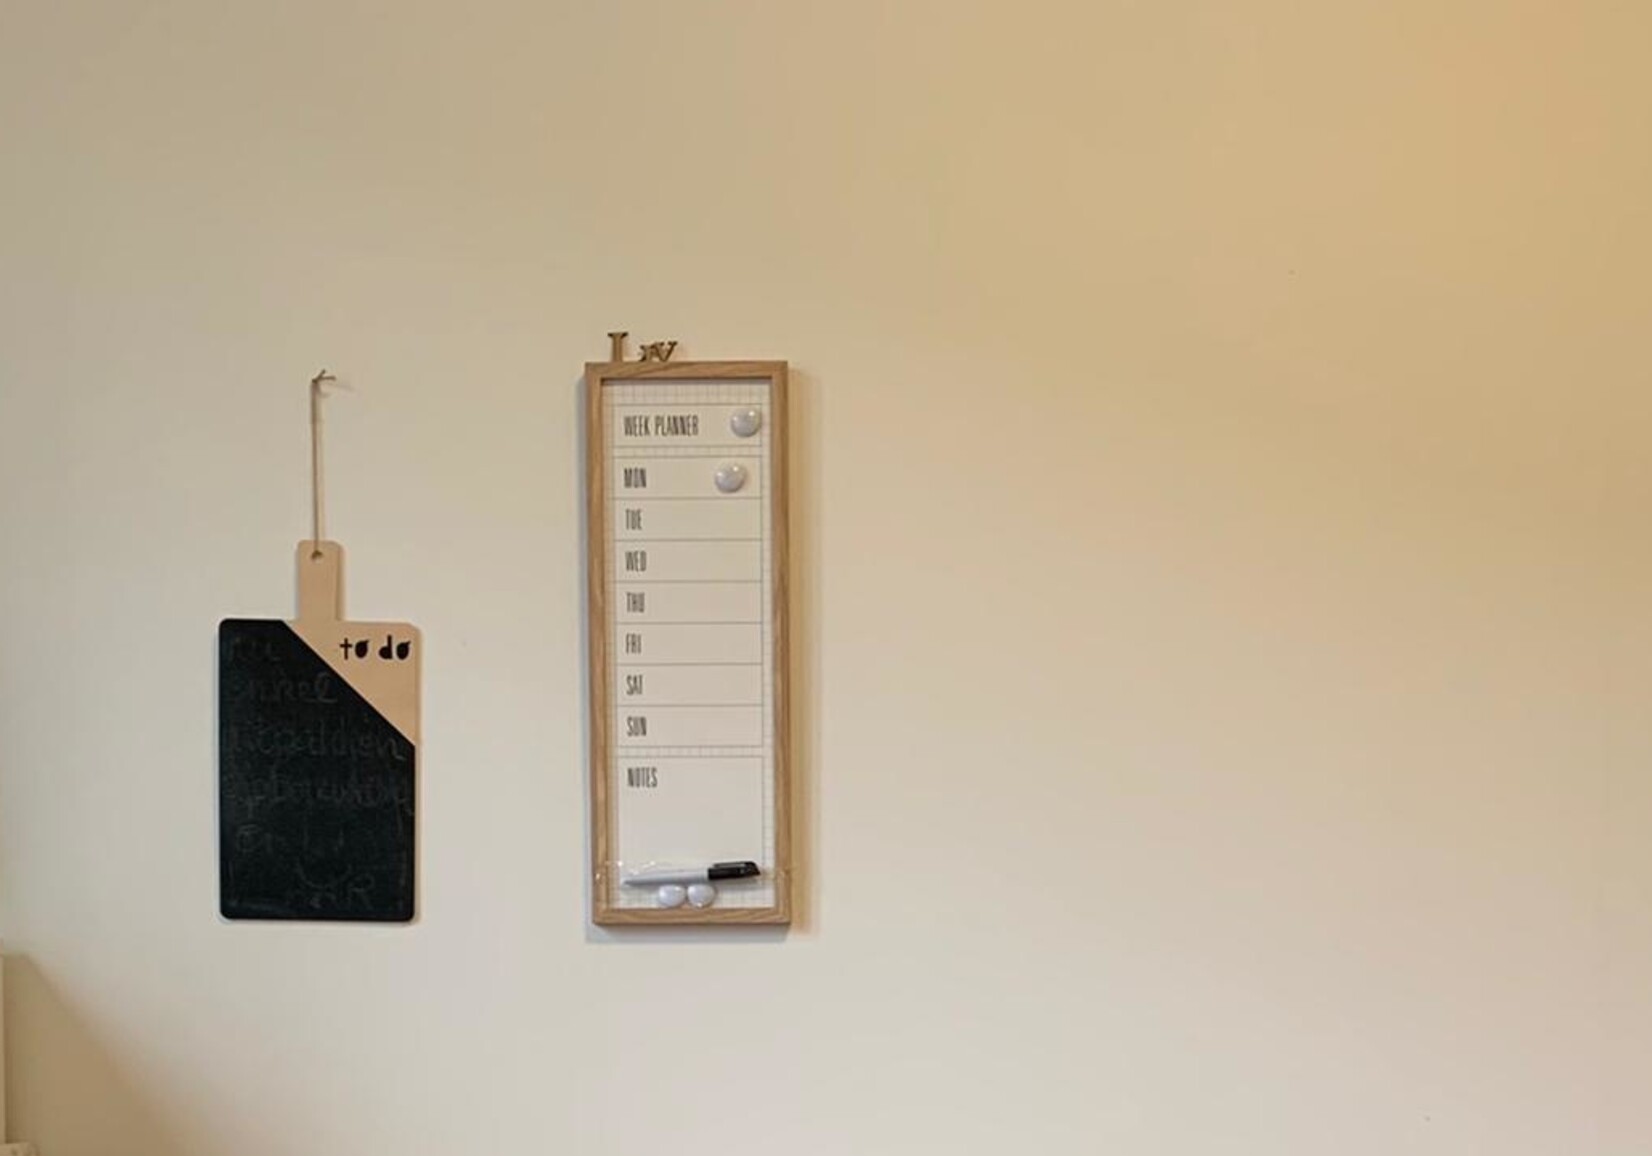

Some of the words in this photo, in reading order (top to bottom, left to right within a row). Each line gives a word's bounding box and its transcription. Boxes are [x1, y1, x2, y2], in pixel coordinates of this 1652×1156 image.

[624, 415, 650, 437] WEEK
[654, 414, 699, 437] PLANNER
[624, 467, 647, 488] MON
[625, 509, 642, 530] TUE
[625, 551, 647, 572] WED
[626, 592, 645, 613] THU
[339, 638, 369, 660] to
[378, 634, 411, 660] do
[626, 633, 642, 654] FRI
[626, 675, 643, 695] SAT
[627, 716, 647, 737] SUN
[627, 767, 658, 788] NOTES
